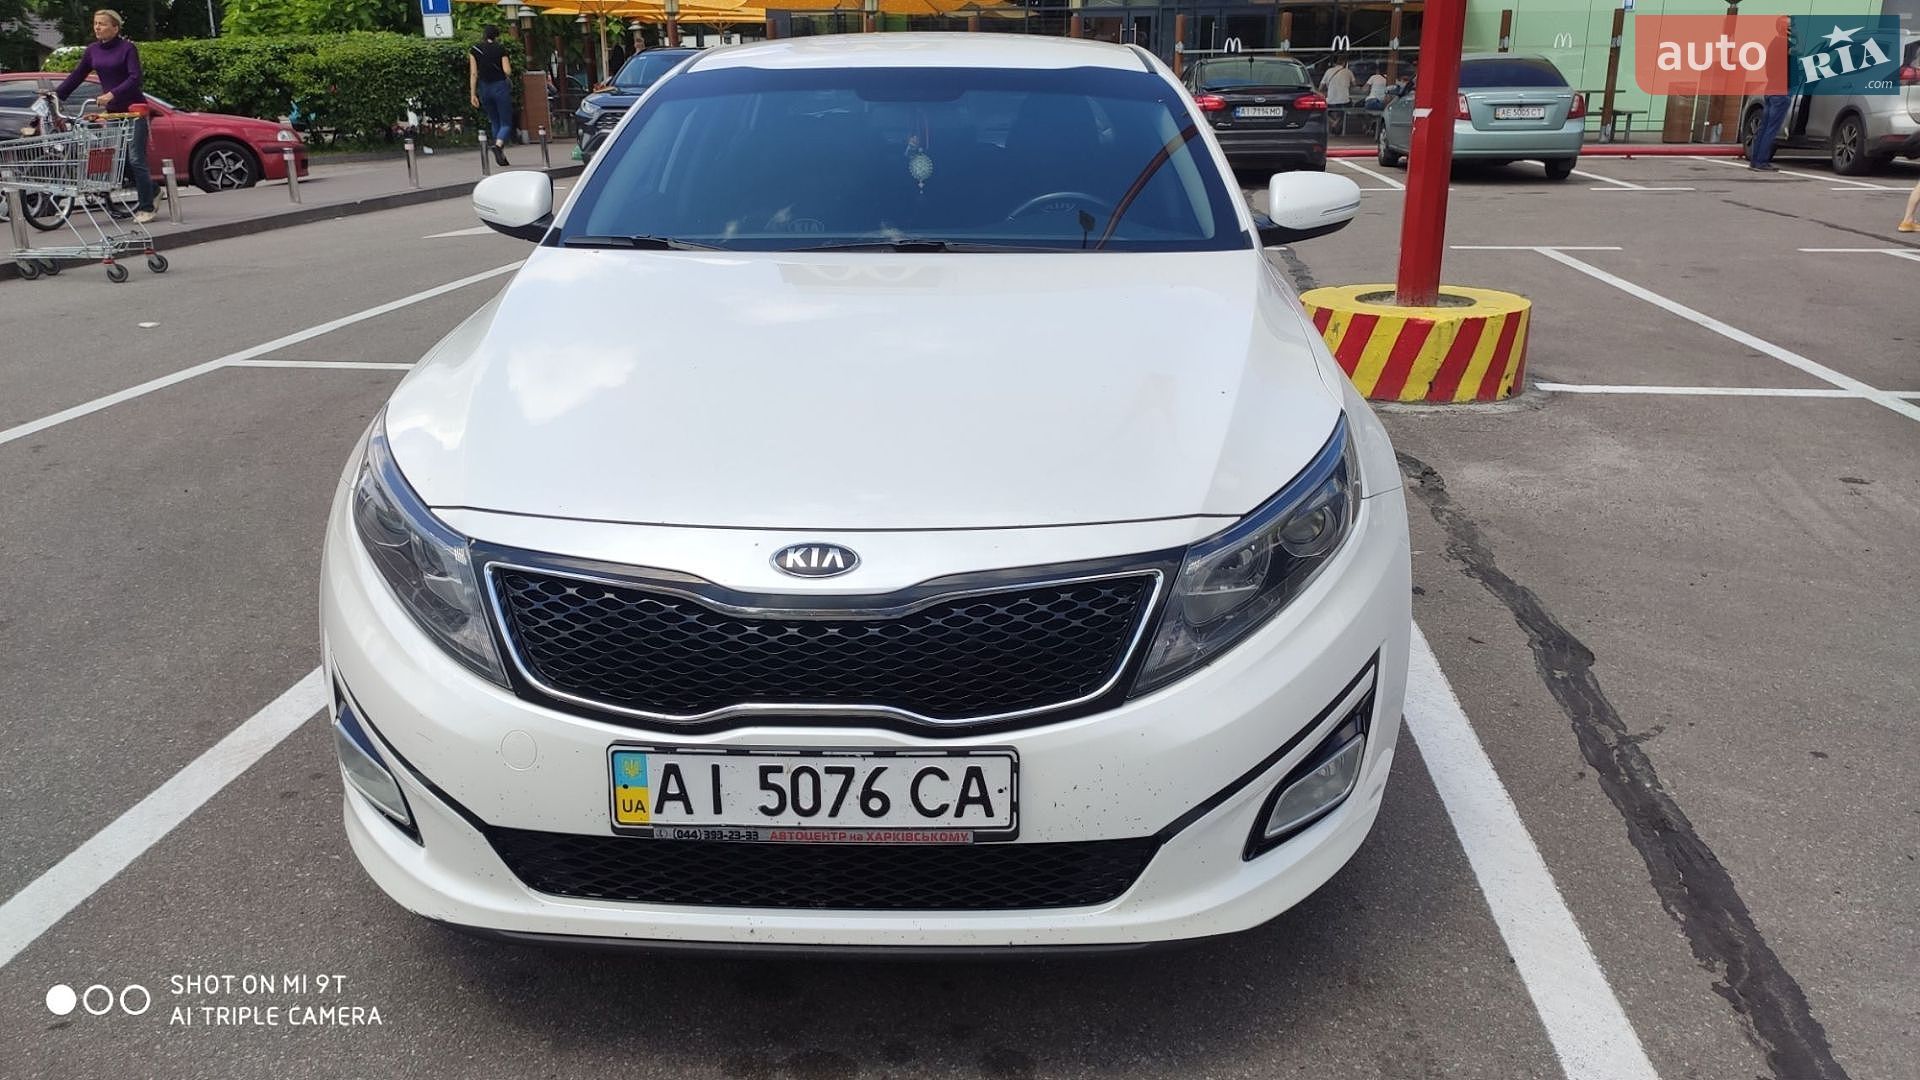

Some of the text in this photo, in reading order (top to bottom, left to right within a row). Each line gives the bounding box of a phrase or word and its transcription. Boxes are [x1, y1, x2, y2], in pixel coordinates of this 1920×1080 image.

[785, 547, 845, 568] KIA
[654, 763, 994, 818] AI 5076 CA
[622, 799, 646, 813] UA
[769, 829, 847, 842] АВТОЦЕНТР
